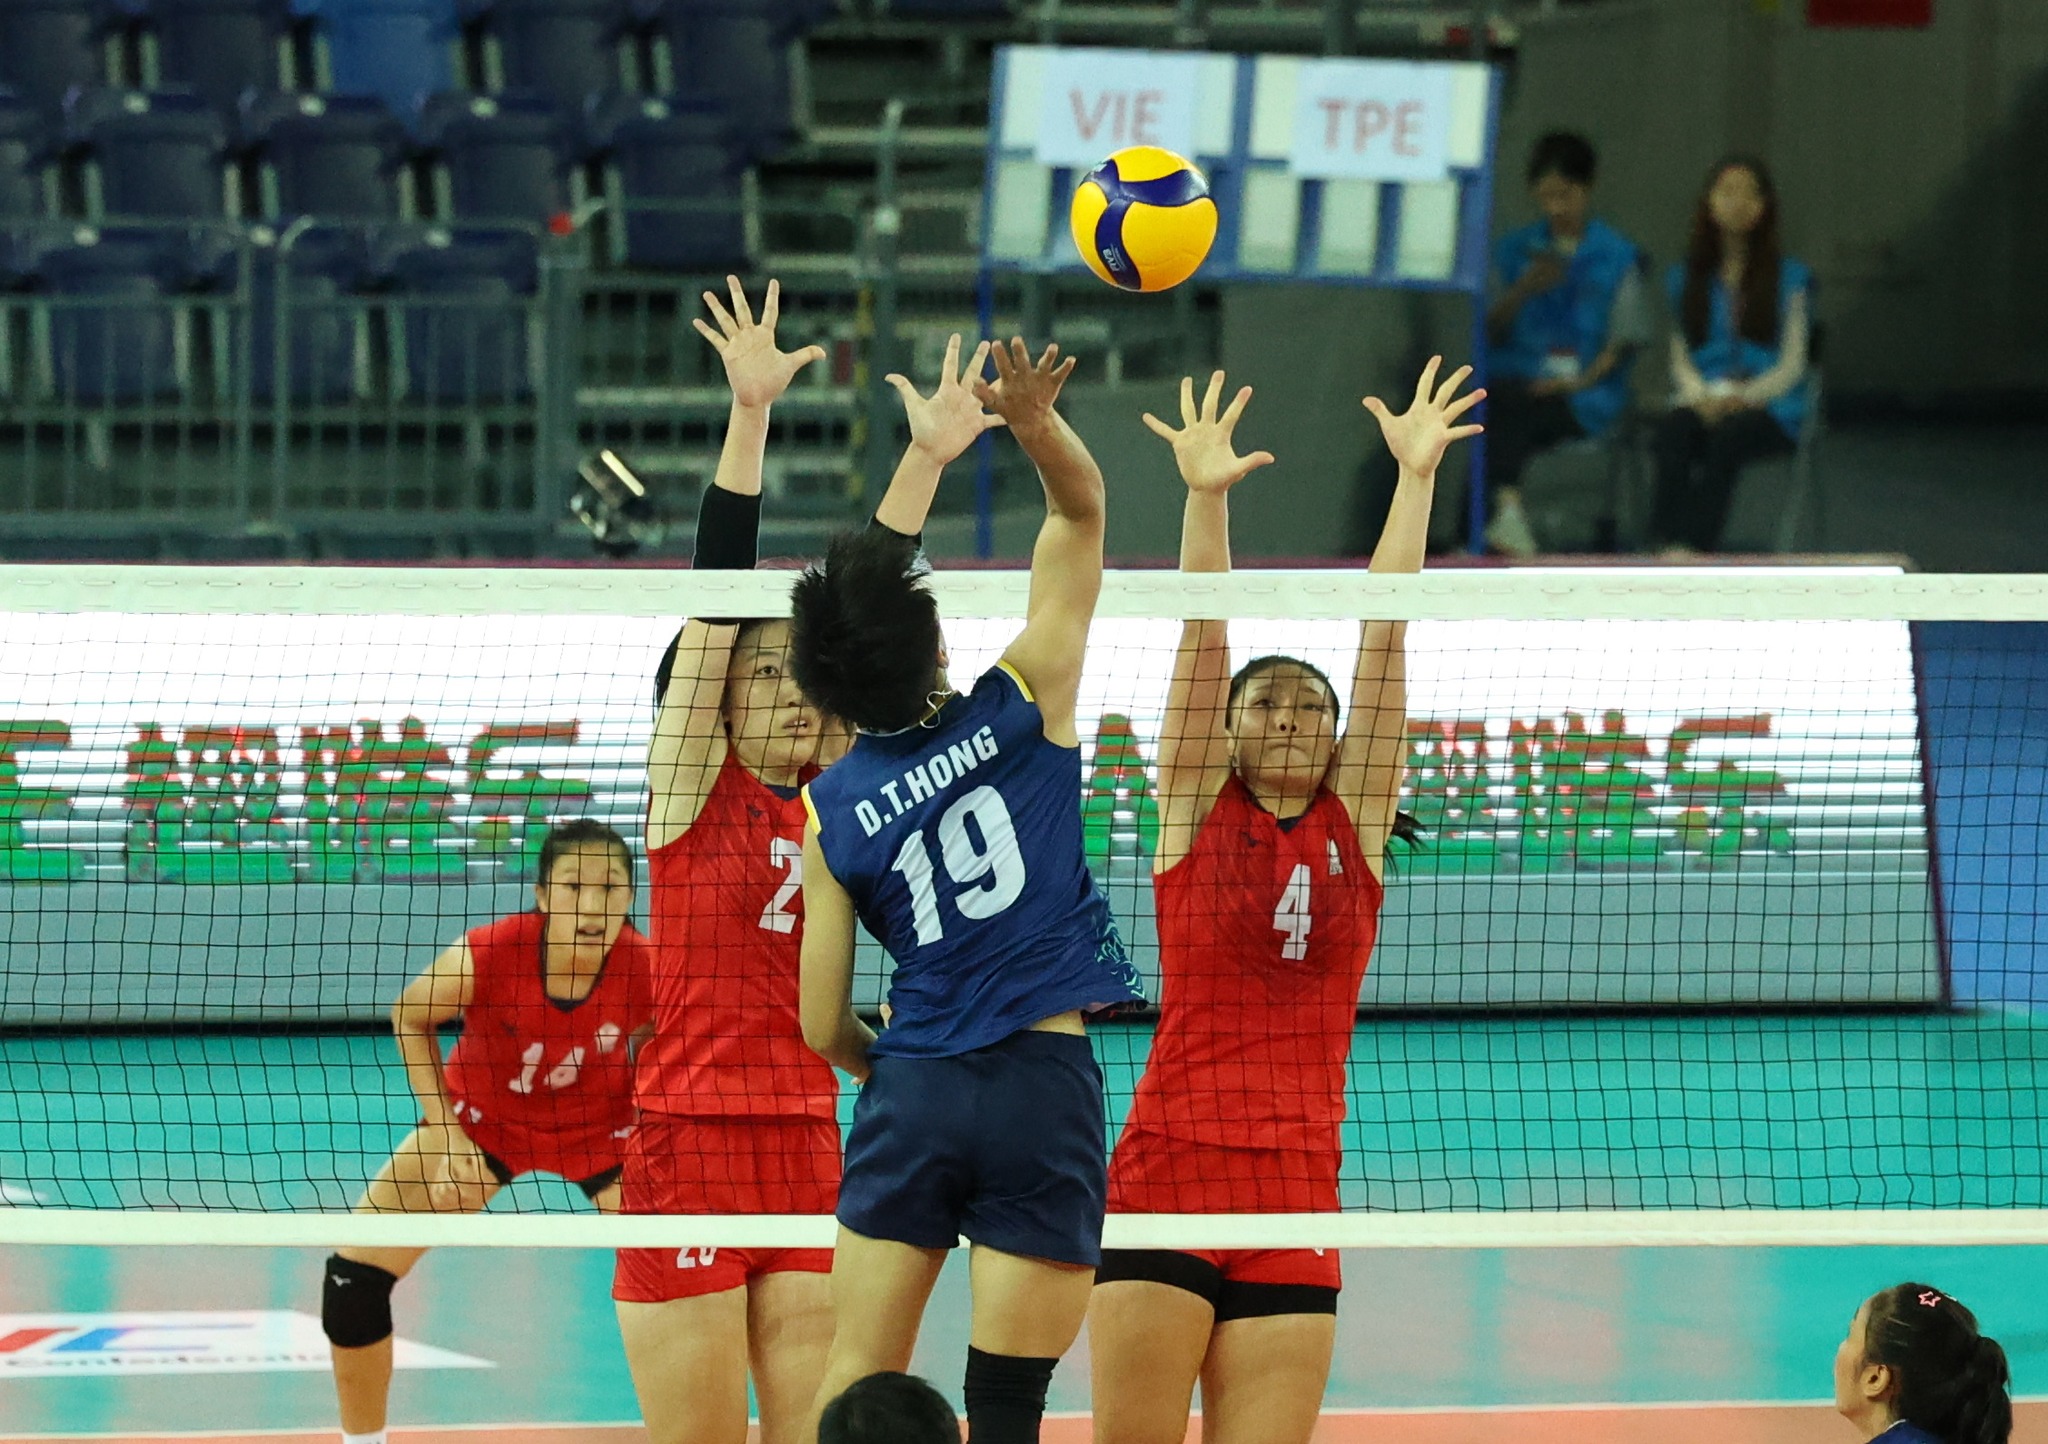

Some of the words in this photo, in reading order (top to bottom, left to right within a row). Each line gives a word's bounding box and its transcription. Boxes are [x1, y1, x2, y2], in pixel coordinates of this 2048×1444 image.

[1069, 89, 1164, 145] VIE
[1317, 98, 1424, 157] TPE
[854, 725, 999, 838] D.T.HONG
[891, 785, 1026, 947] 19
[1273, 863, 1312, 961] 4
